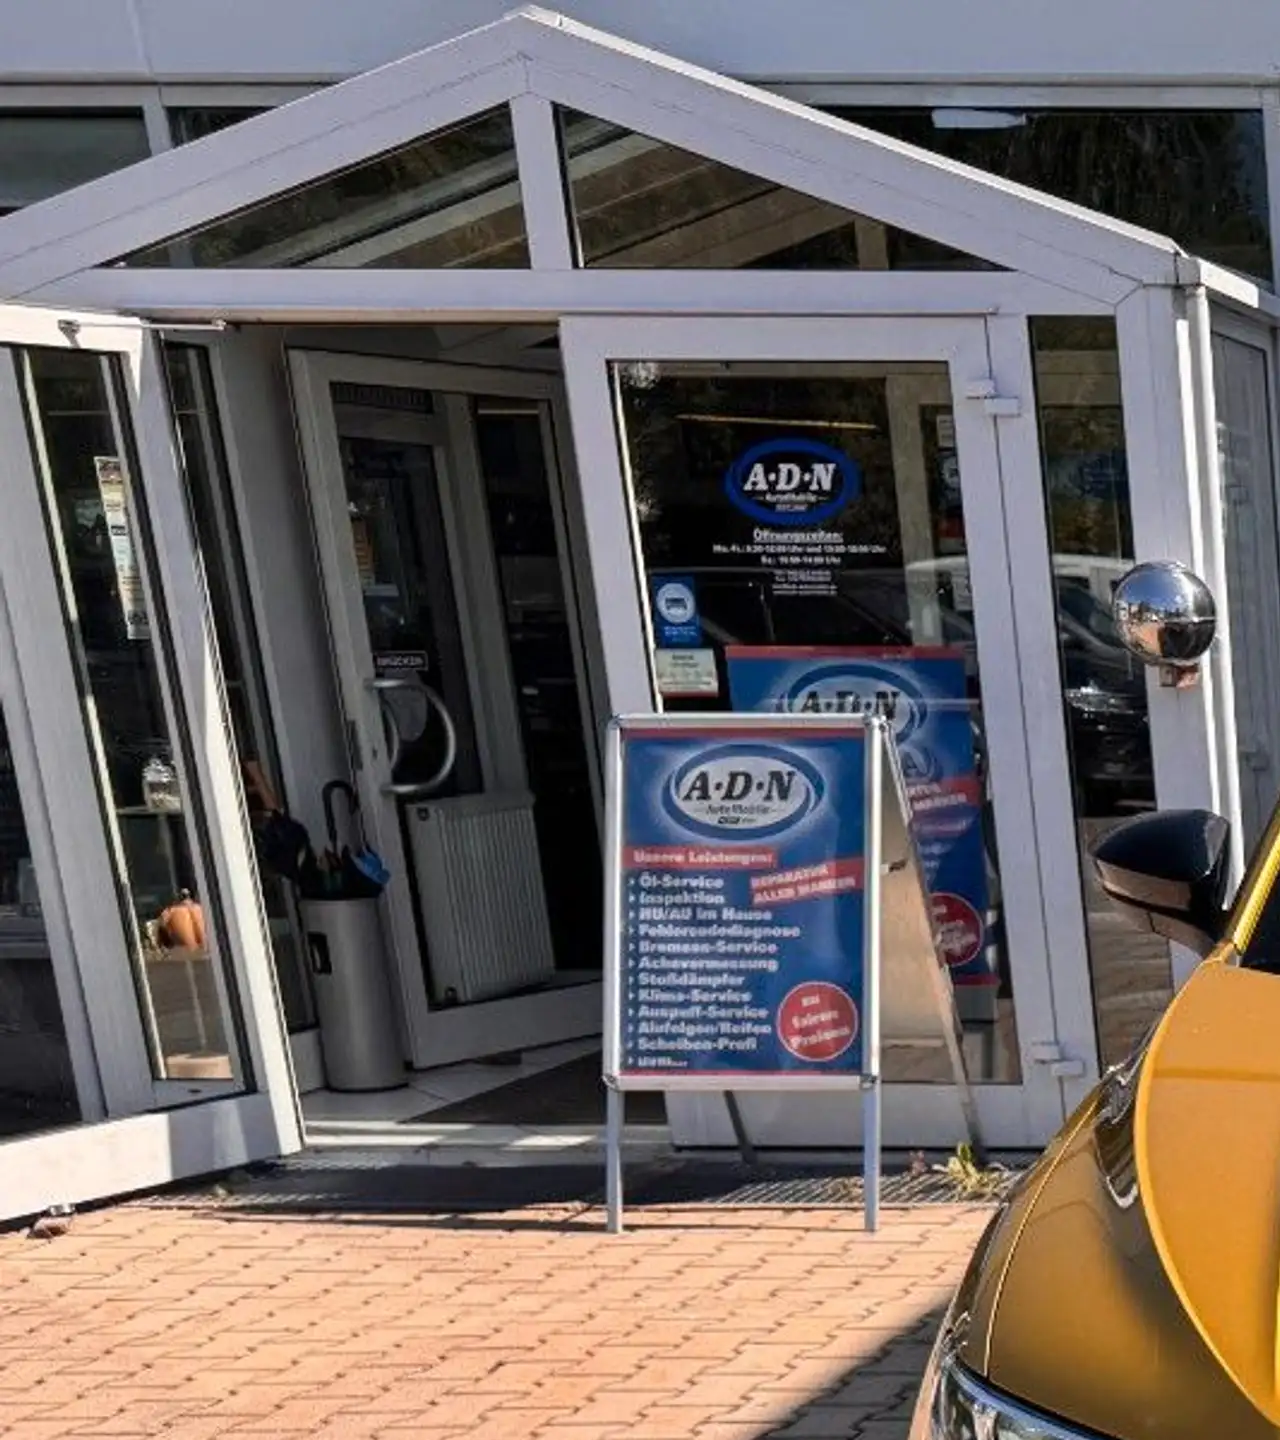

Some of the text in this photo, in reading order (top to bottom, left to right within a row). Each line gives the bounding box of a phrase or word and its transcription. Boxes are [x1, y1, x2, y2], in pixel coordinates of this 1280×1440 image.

[634, 849, 684, 862] Unsere
[639, 871, 724, 888] Öl-Service
[639, 891, 725, 906] Inspektion
[639, 908, 772, 921] HU/AU im Hause
[639, 941, 778, 953] Bremsen-Service
[638, 957, 779, 972] Achsvermessung
[638, 973, 745, 989] Stoßdämpfer
[638, 990, 752, 1002] Klima-Service
[638, 1005, 768, 1020] Auspuff-Service
[638, 1021, 772, 1036] Alufelgen/Reifen
[638, 1037, 757, 1050] Scheiben-Profi
